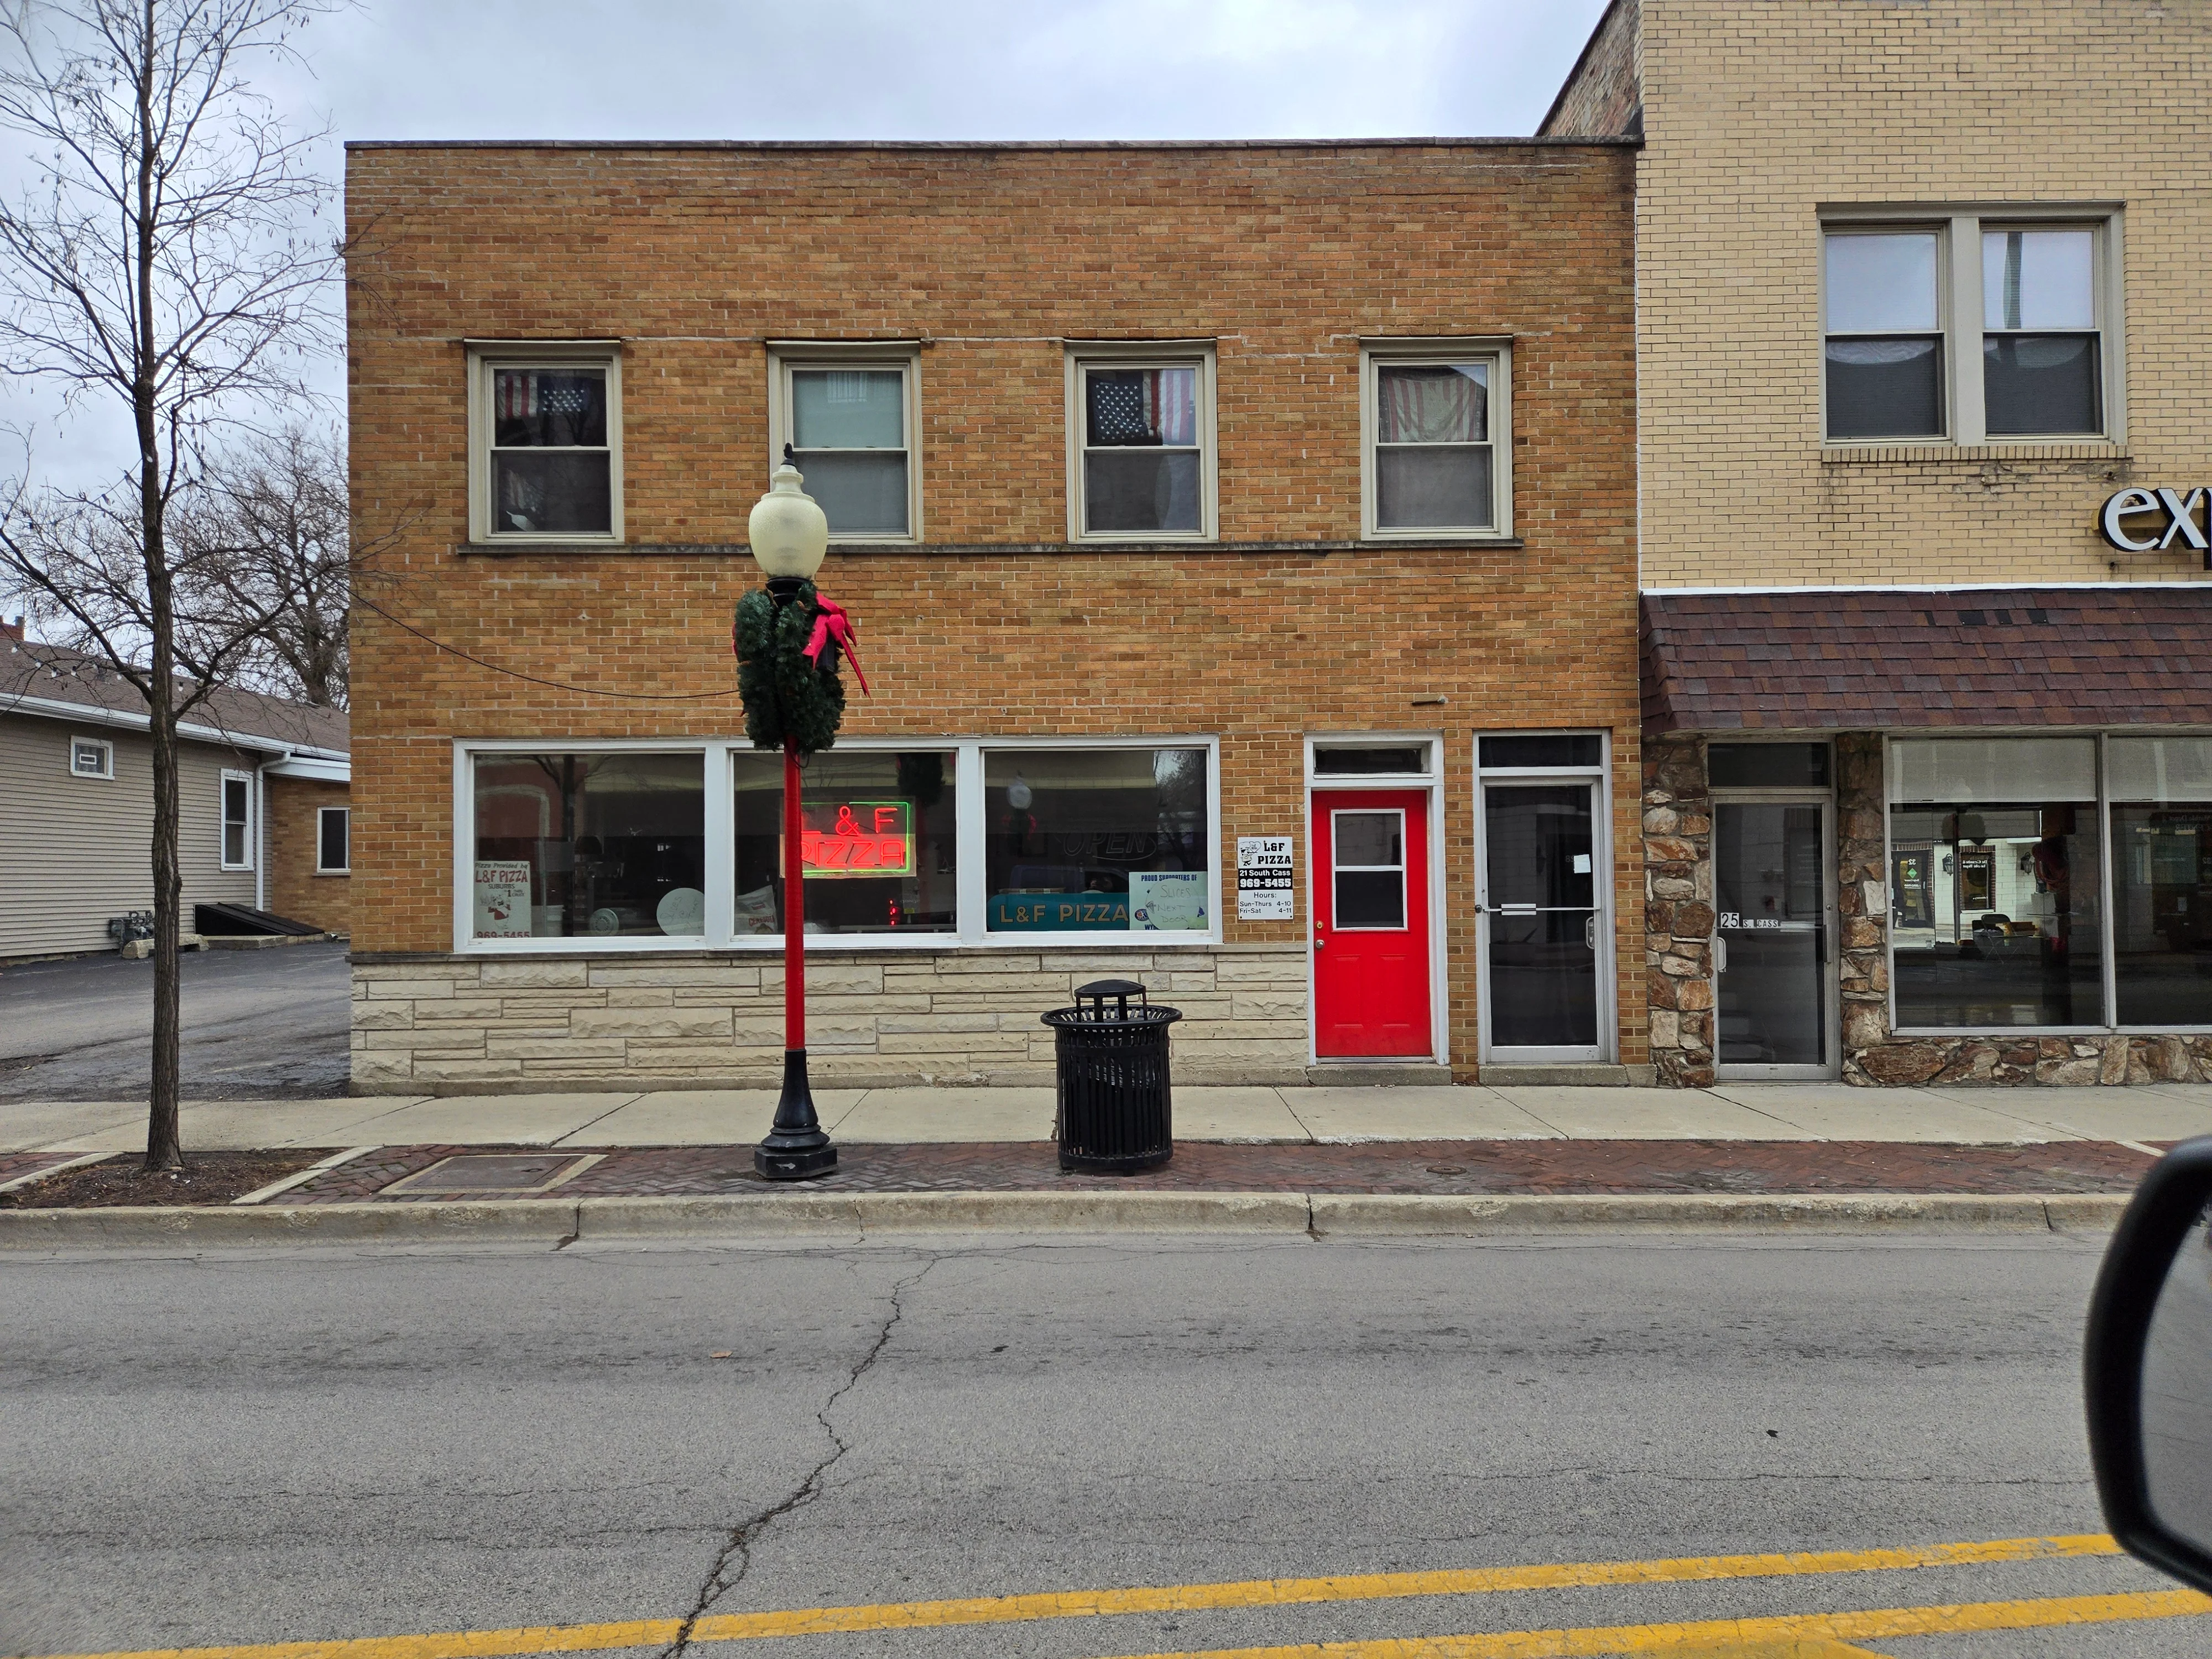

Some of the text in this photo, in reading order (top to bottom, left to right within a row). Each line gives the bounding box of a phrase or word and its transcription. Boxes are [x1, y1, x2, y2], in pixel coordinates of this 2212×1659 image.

[2099, 487, 2212, 571] ex
[836, 806, 860, 836] &
[875, 807, 898, 834] F
[1063, 827, 1147, 856] OPEN
[1264, 842, 1285, 852] L&F
[1258, 855, 1291, 864] PIZZA
[476, 870, 528, 883] L&F PIZZA
[1240, 879, 1291, 887] 969-5455
[1160, 885, 1191, 899] SLICES
[1000, 904, 1046, 924] L&F
[1060, 904, 1129, 922] PIZZA
[1157, 903, 1186, 912] NEXT
[1161, 915, 1188, 923] DOOR
[1721, 914, 1738, 928] 25
